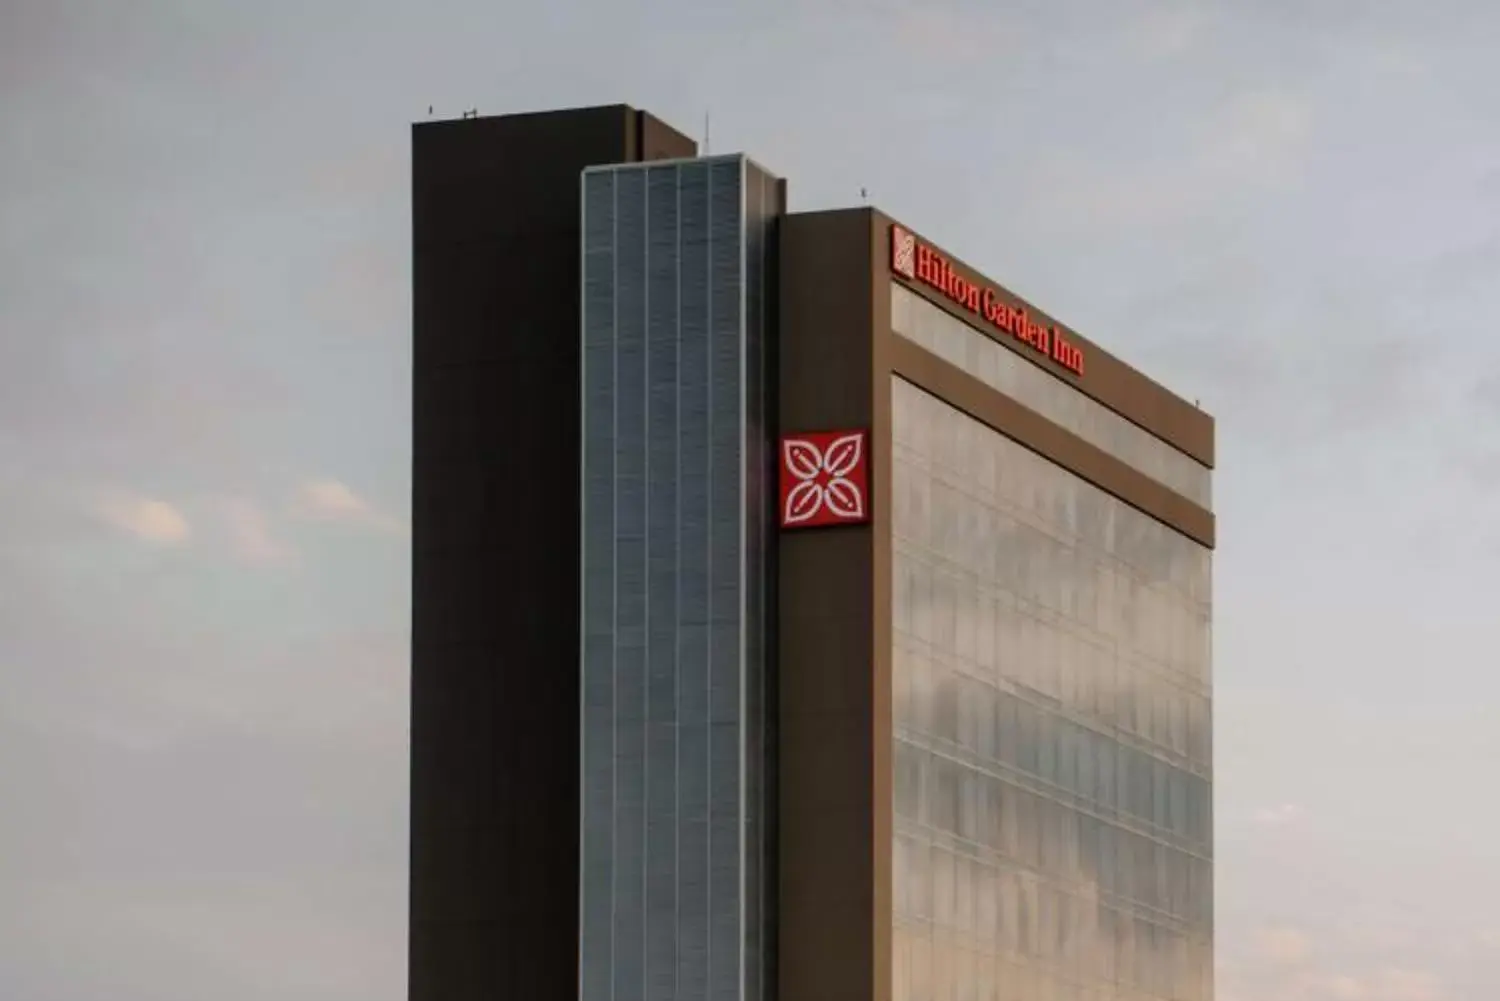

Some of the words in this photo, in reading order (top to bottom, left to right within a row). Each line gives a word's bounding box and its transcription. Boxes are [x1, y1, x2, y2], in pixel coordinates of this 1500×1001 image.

[916, 243, 980, 314] Hilton
[981, 287, 1049, 357] Garden
[1052, 325, 1085, 377] Inn
